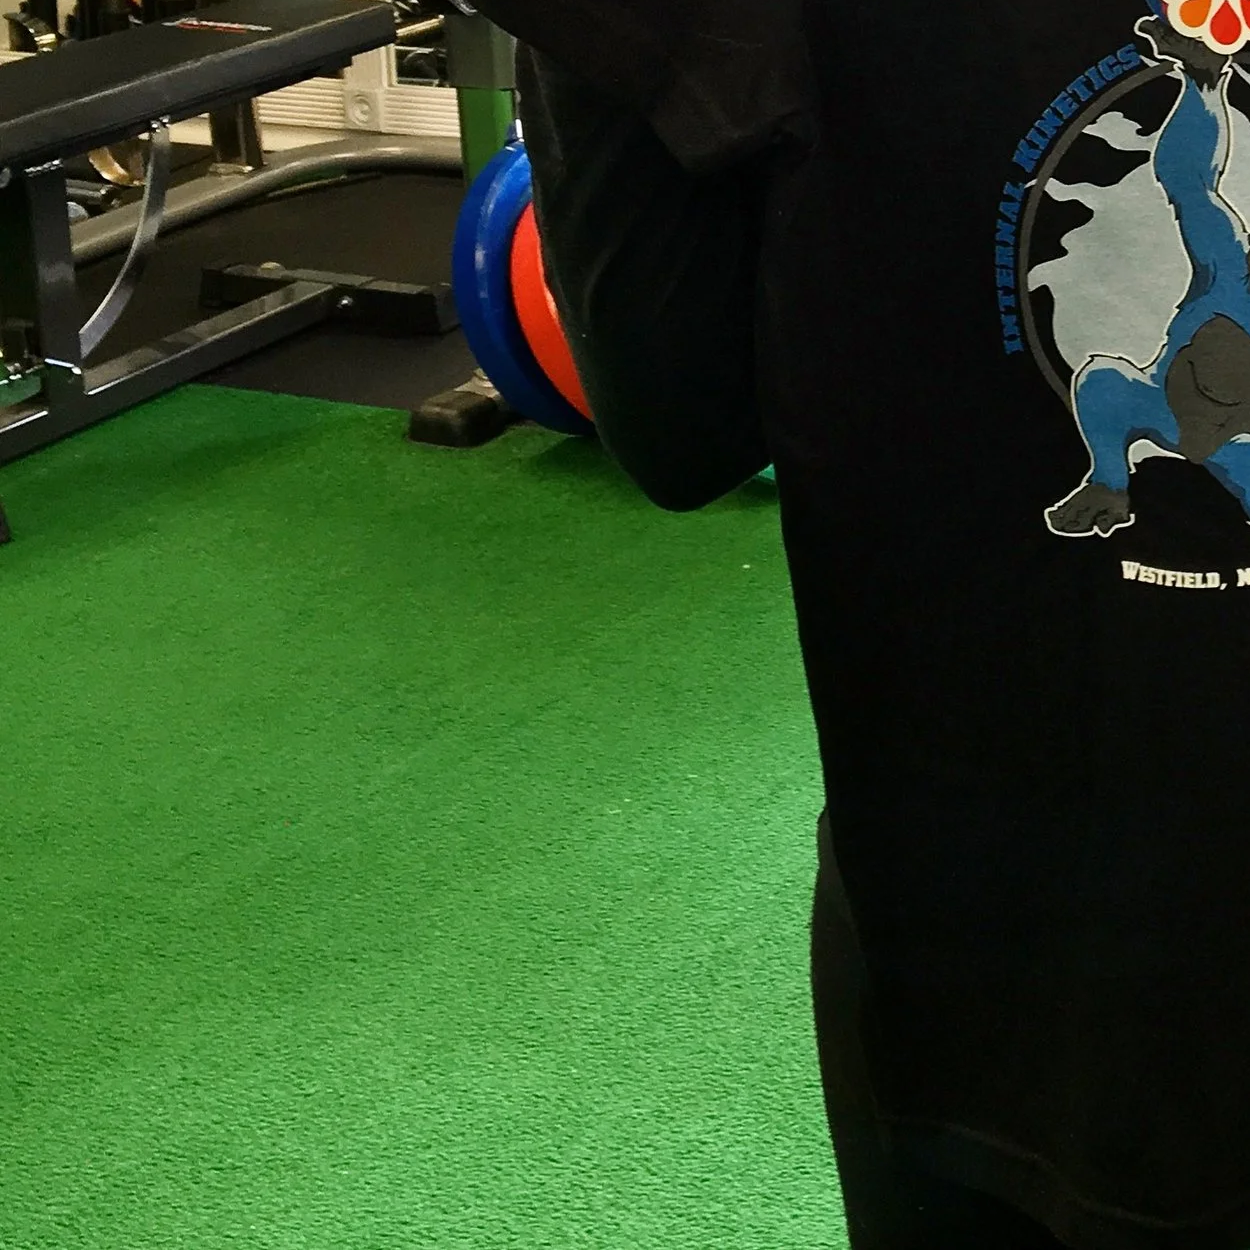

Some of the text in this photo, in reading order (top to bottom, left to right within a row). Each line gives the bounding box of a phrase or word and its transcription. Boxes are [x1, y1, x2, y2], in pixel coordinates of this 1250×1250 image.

[995, 43, 1142, 355] INTERNAL KINETICS
[1121, 561, 1228, 590] WESTFIELD,
